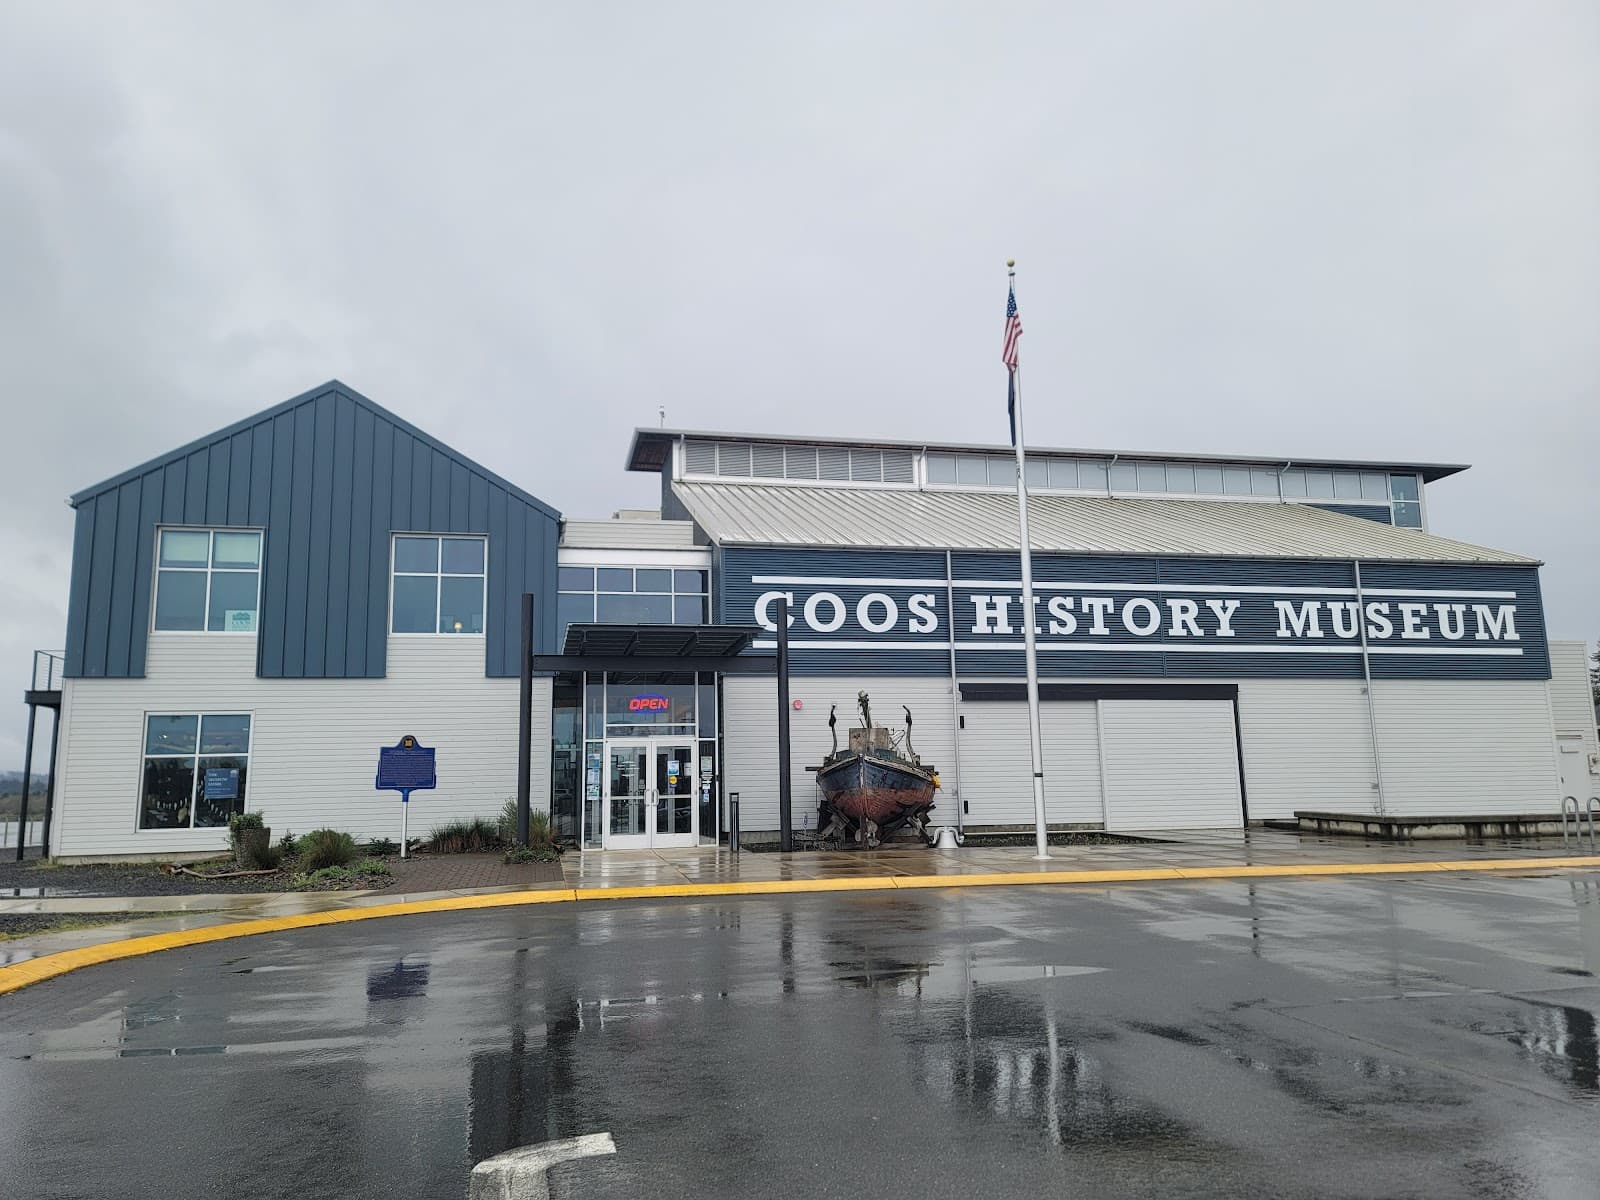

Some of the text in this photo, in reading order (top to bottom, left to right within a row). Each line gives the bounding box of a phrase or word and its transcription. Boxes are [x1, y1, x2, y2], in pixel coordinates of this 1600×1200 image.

[754, 591, 939, 633] COOS
[1273, 600, 1521, 641] MUSEUM
[628, 698, 669, 711] OPEN
